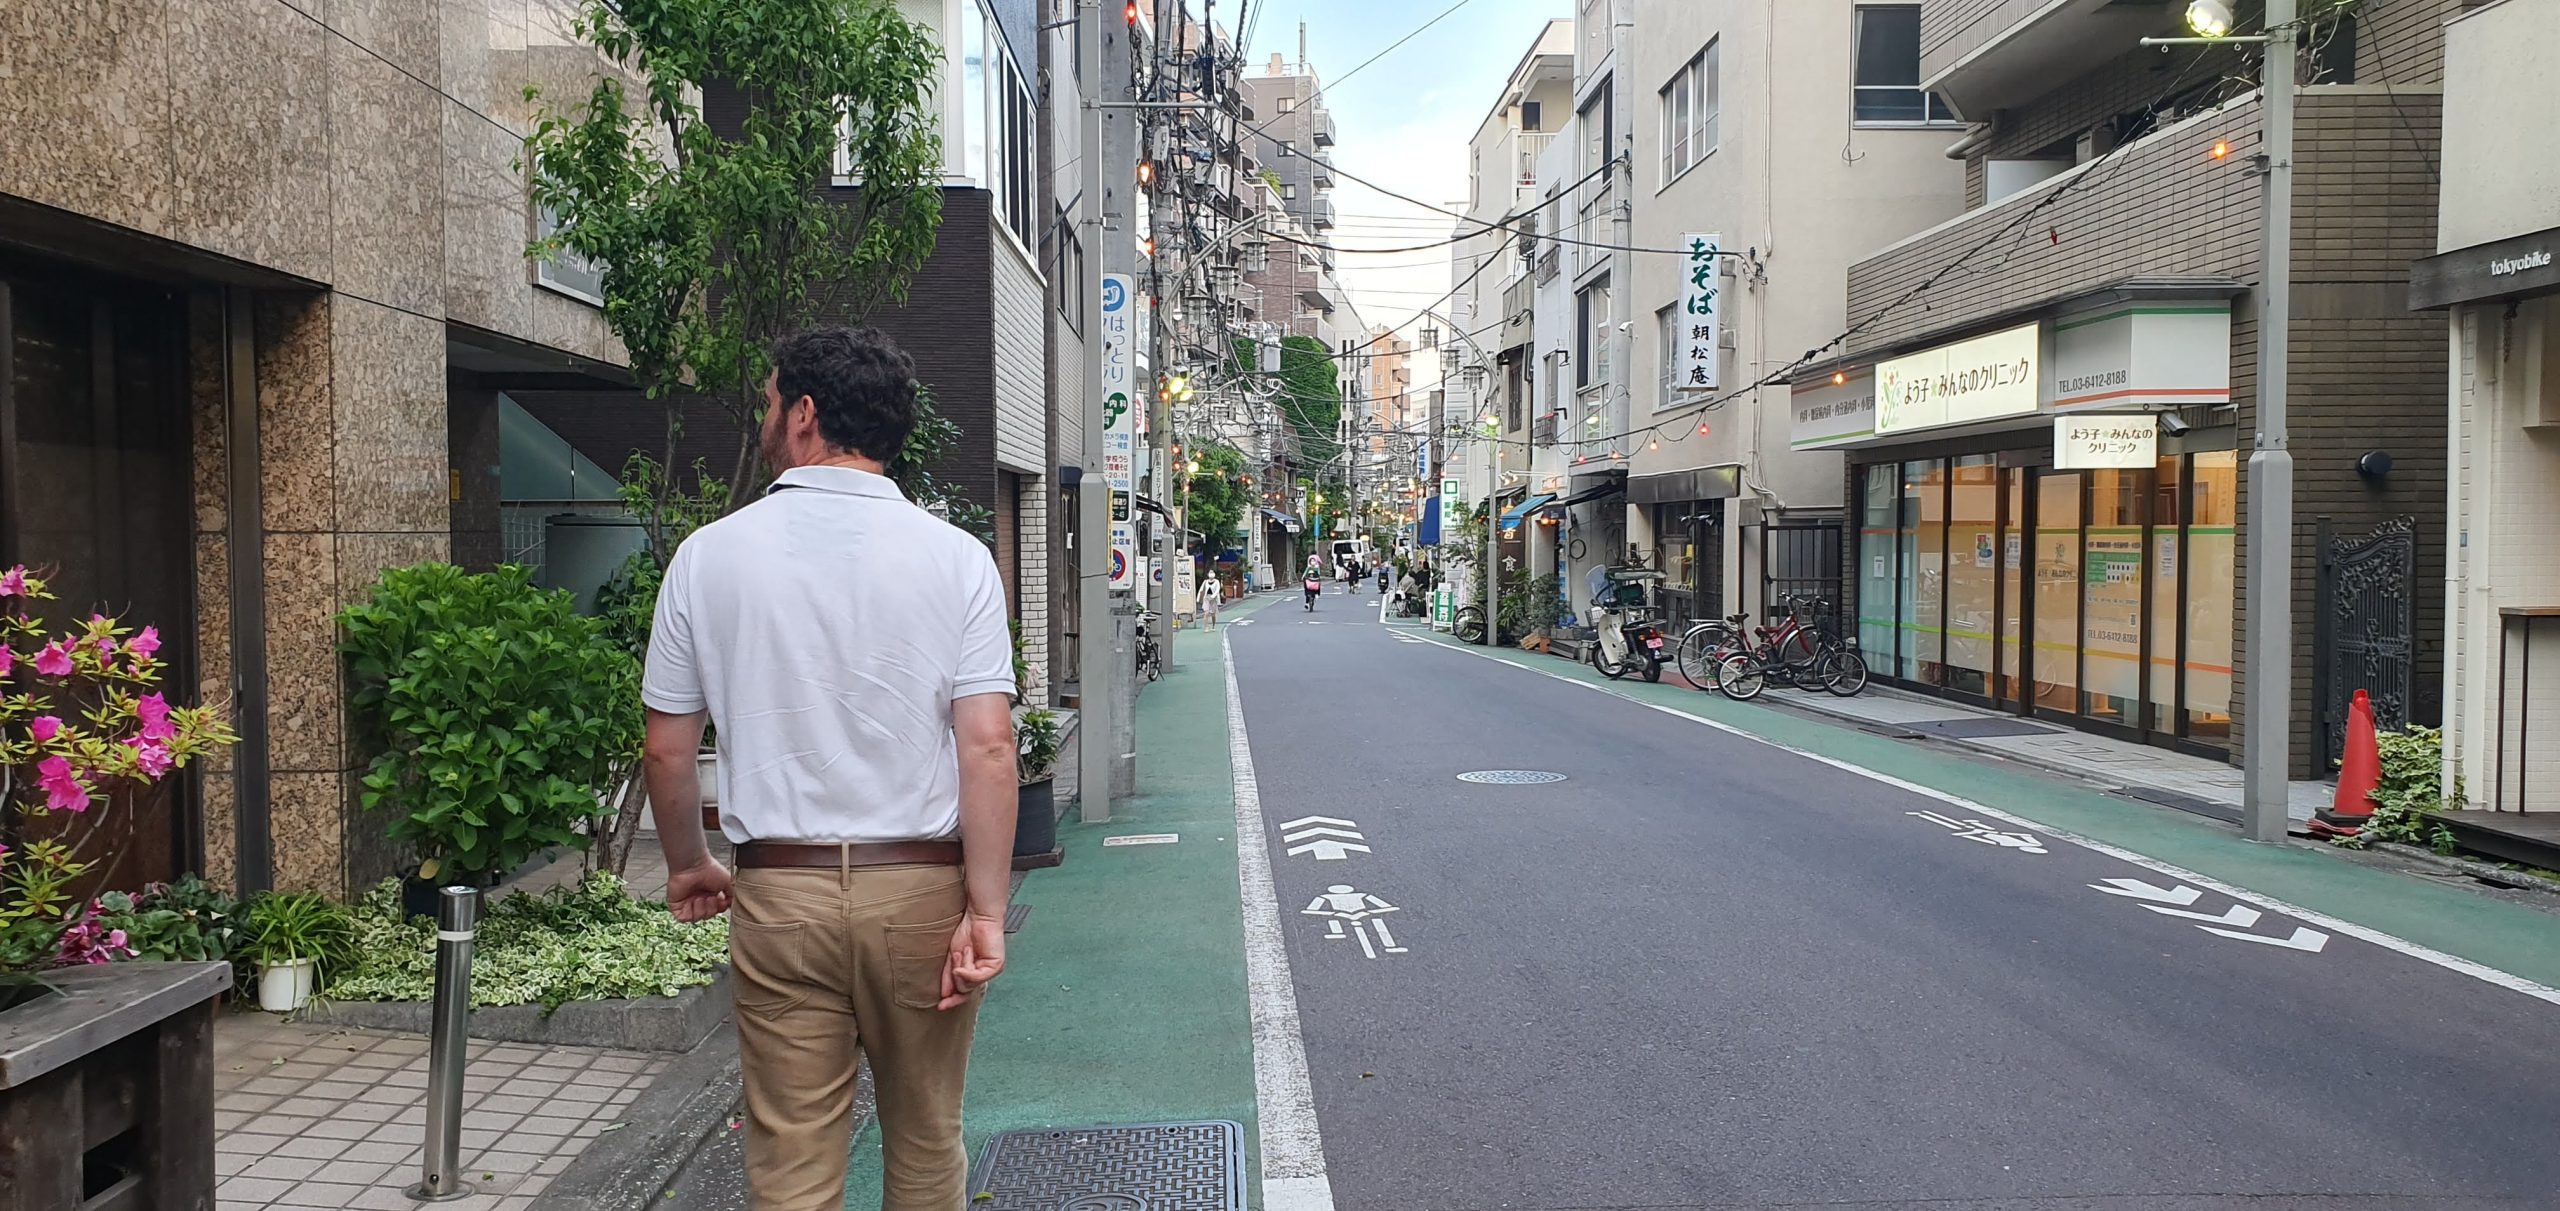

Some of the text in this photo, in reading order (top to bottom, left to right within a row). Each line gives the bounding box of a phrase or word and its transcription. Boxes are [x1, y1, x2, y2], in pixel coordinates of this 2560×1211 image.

[2490, 250, 2552, 276] tokyobike
[1688, 237, 1718, 386] おそば 朝松庵
[1110, 315, 1126, 383] はっとり
[1904, 356, 2029, 405] よう子 みんなのクリニック
[2058, 369, 2127, 394] TEL.03-6412-8188
[1103, 441, 1128, 449] コー検査
[2070, 428, 2153, 440] よう子 みんなの
[1104, 455, 1129, 463] 学校うら
[2088, 442, 2137, 454] クリニック
